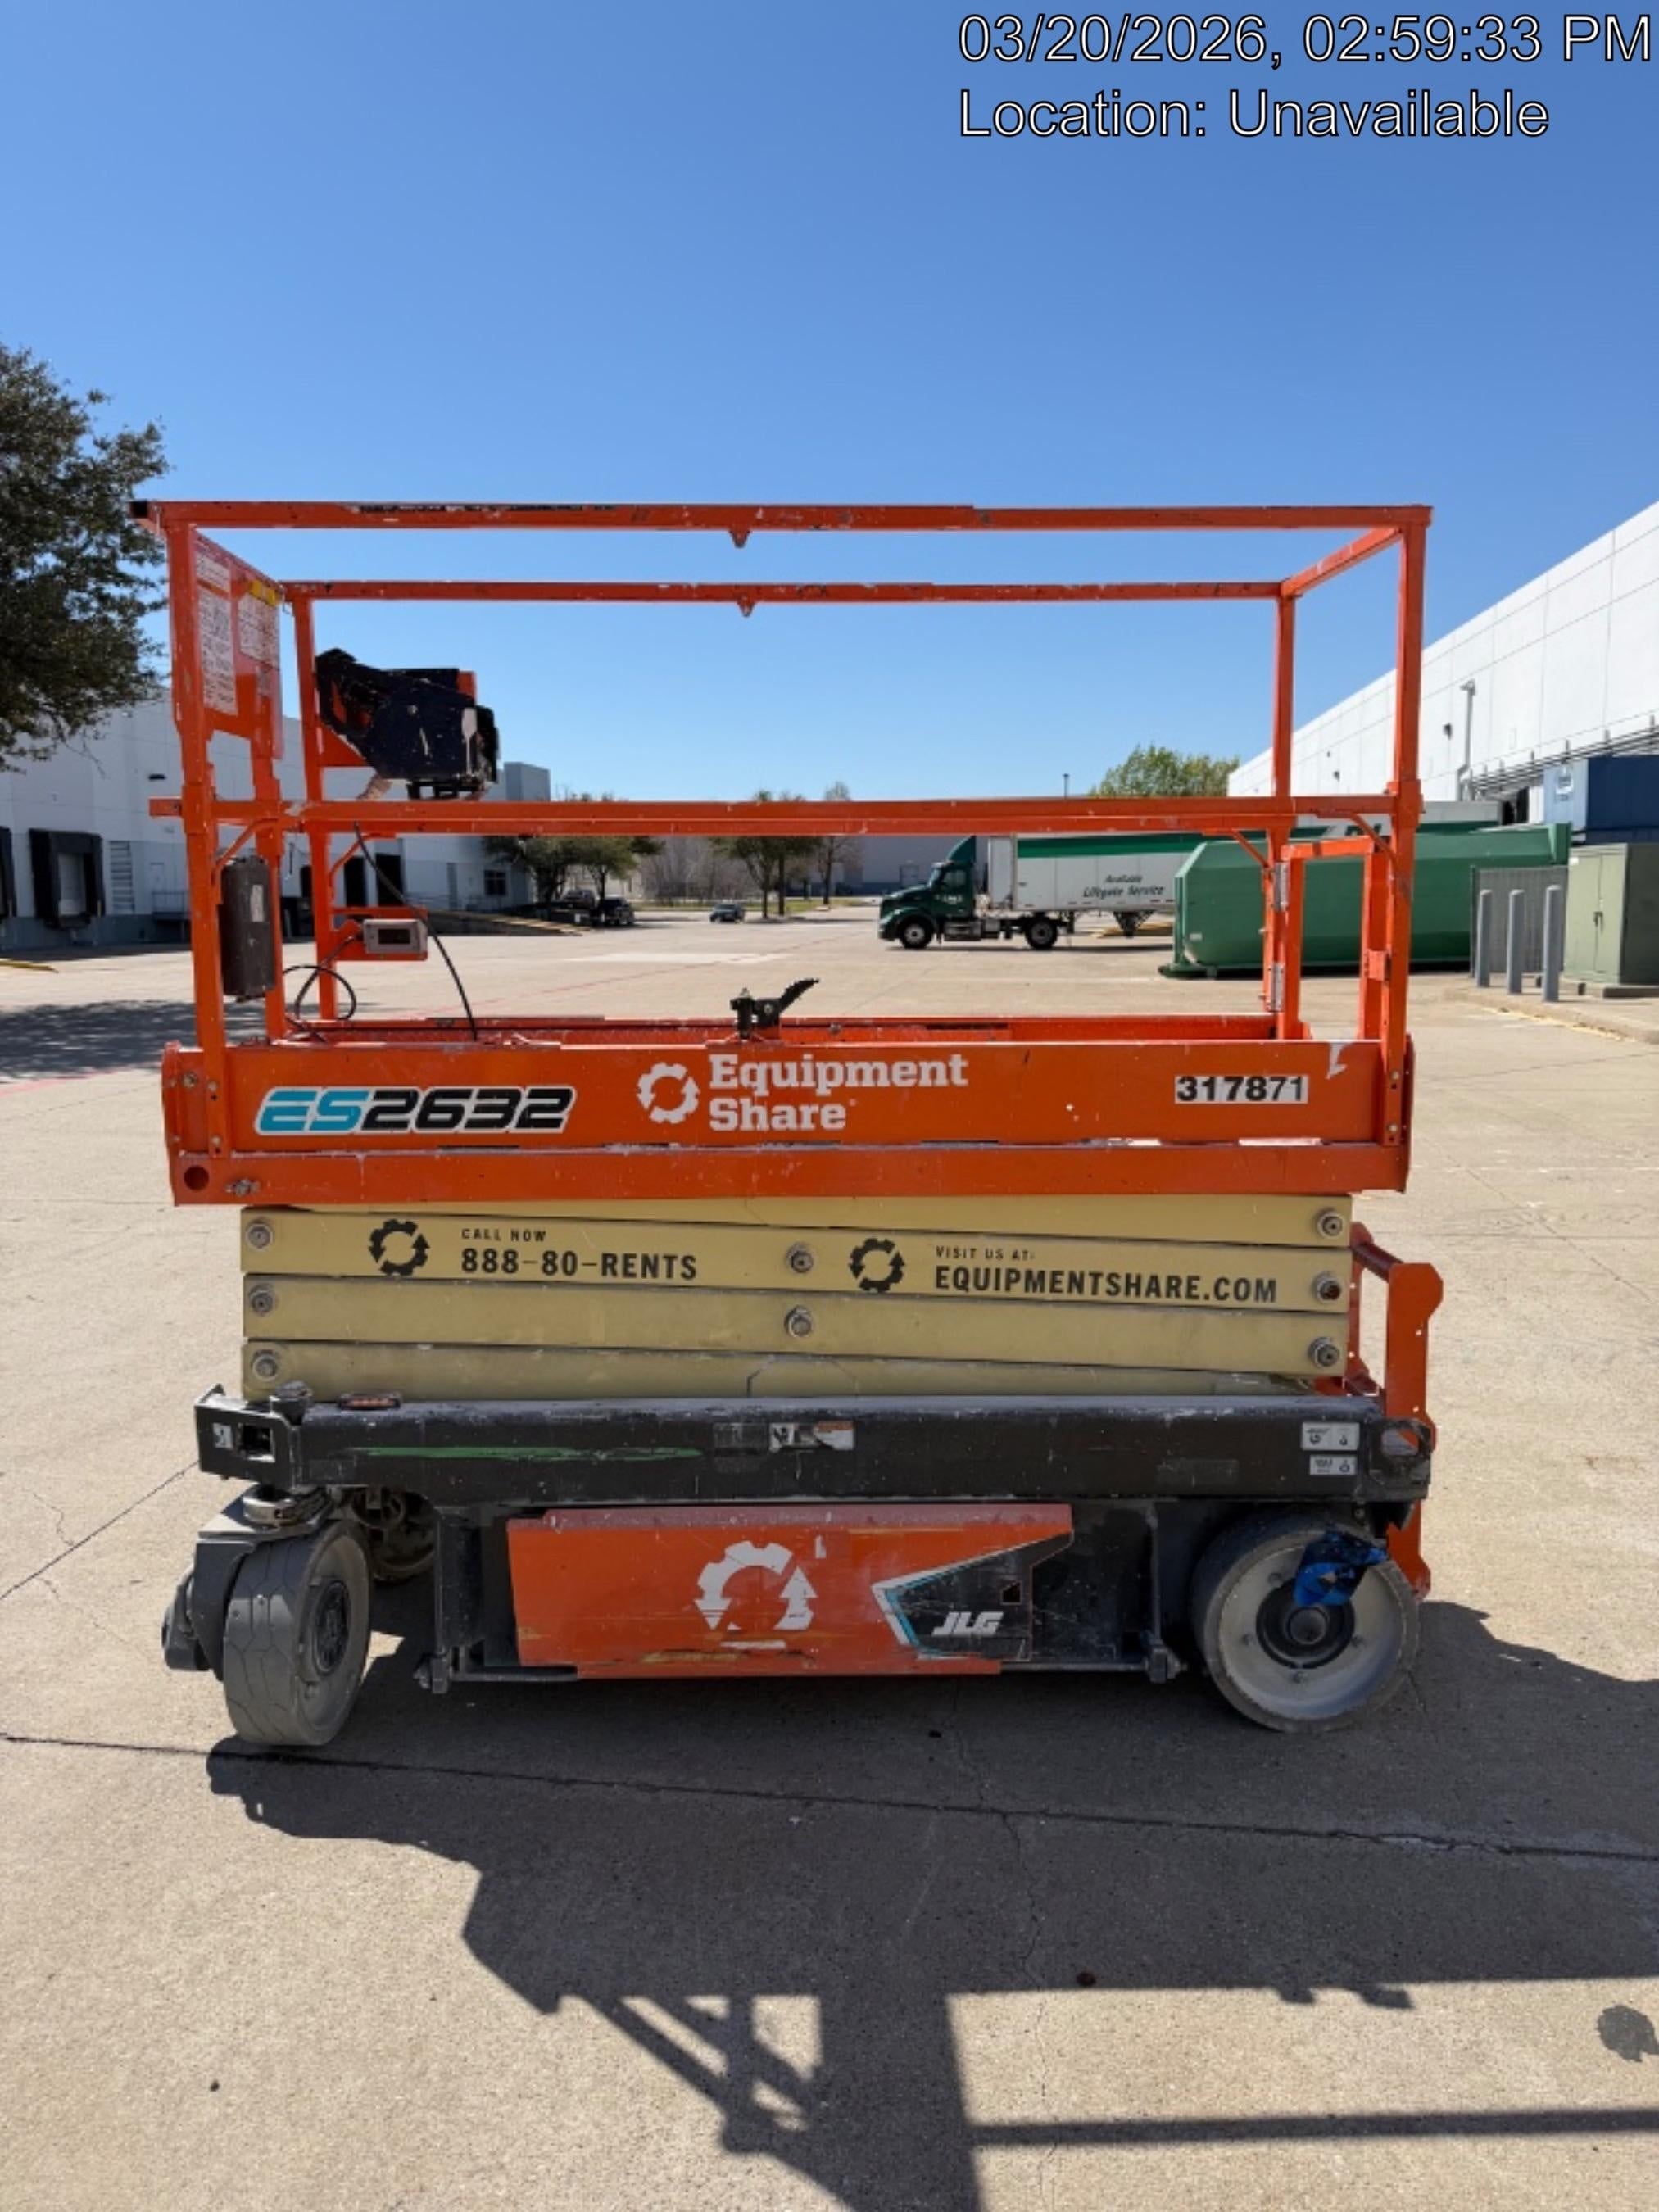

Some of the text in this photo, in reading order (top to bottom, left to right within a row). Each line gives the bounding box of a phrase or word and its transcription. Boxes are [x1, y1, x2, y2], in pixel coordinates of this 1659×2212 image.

[709, 1054, 969, 1096] Equipment
[1176, 1075, 1303, 1102] 317871
[256, 1086, 577, 1134] ES2632
[709, 1097, 847, 1131] Share
[460, 1228, 547, 1243] CALL NOW
[460, 1248, 697, 1280] 888-80-RENTS
[936, 1245, 977, 1259] VISIT
[985, 1248, 1004, 1260] US
[934, 1264, 1277, 1303] EQUIPMENTSHARE.COM
[931, 1611, 1004, 1637] JLG
